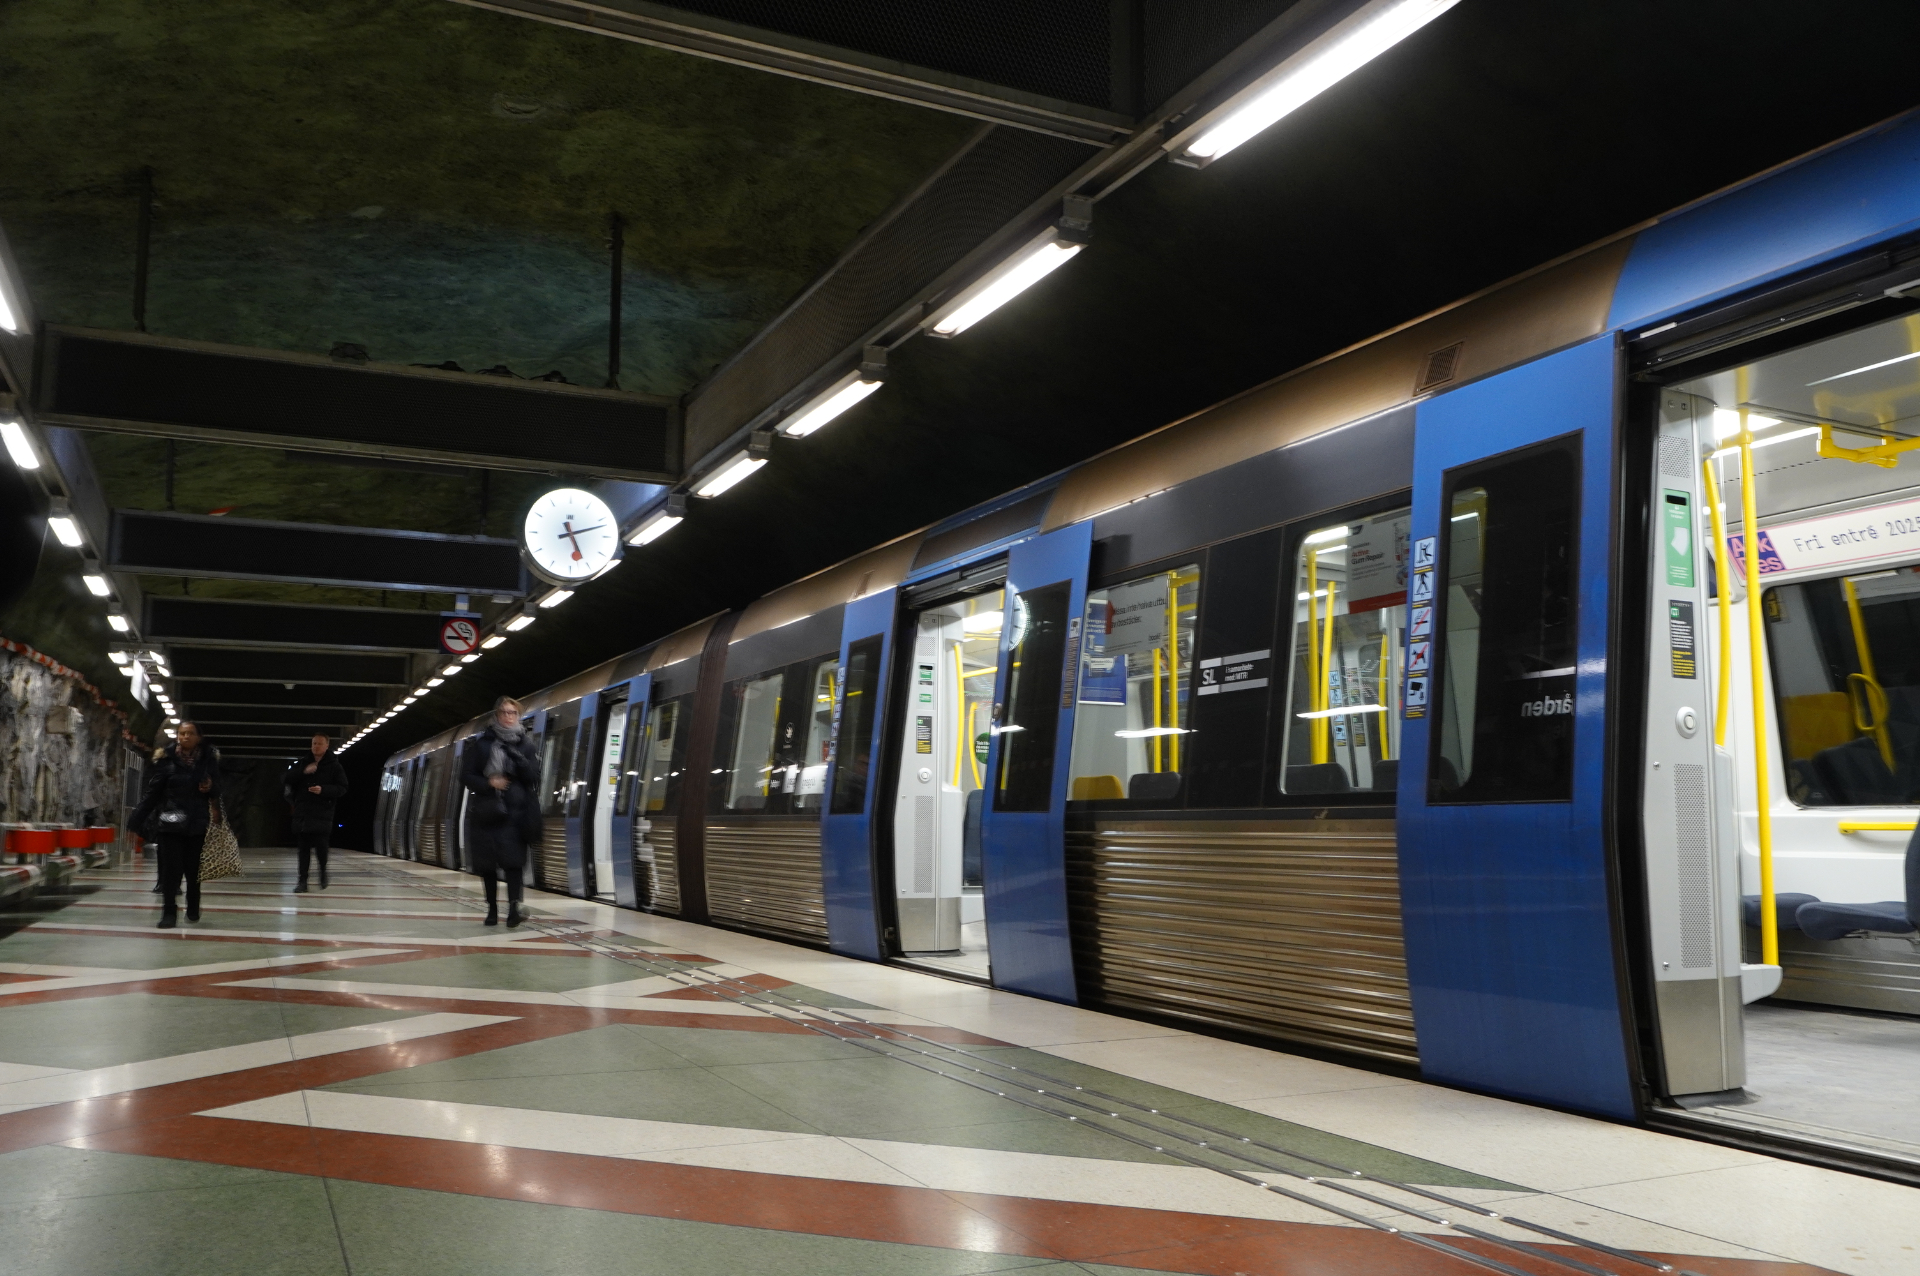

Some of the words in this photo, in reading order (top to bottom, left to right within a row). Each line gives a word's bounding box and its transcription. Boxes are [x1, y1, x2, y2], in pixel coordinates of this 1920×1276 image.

[1731, 537, 1775, 557] Ak
[1793, 534, 1825, 552] Fri
[1831, 525, 1879, 545] entré
[1202, 669, 1217, 685] SL
